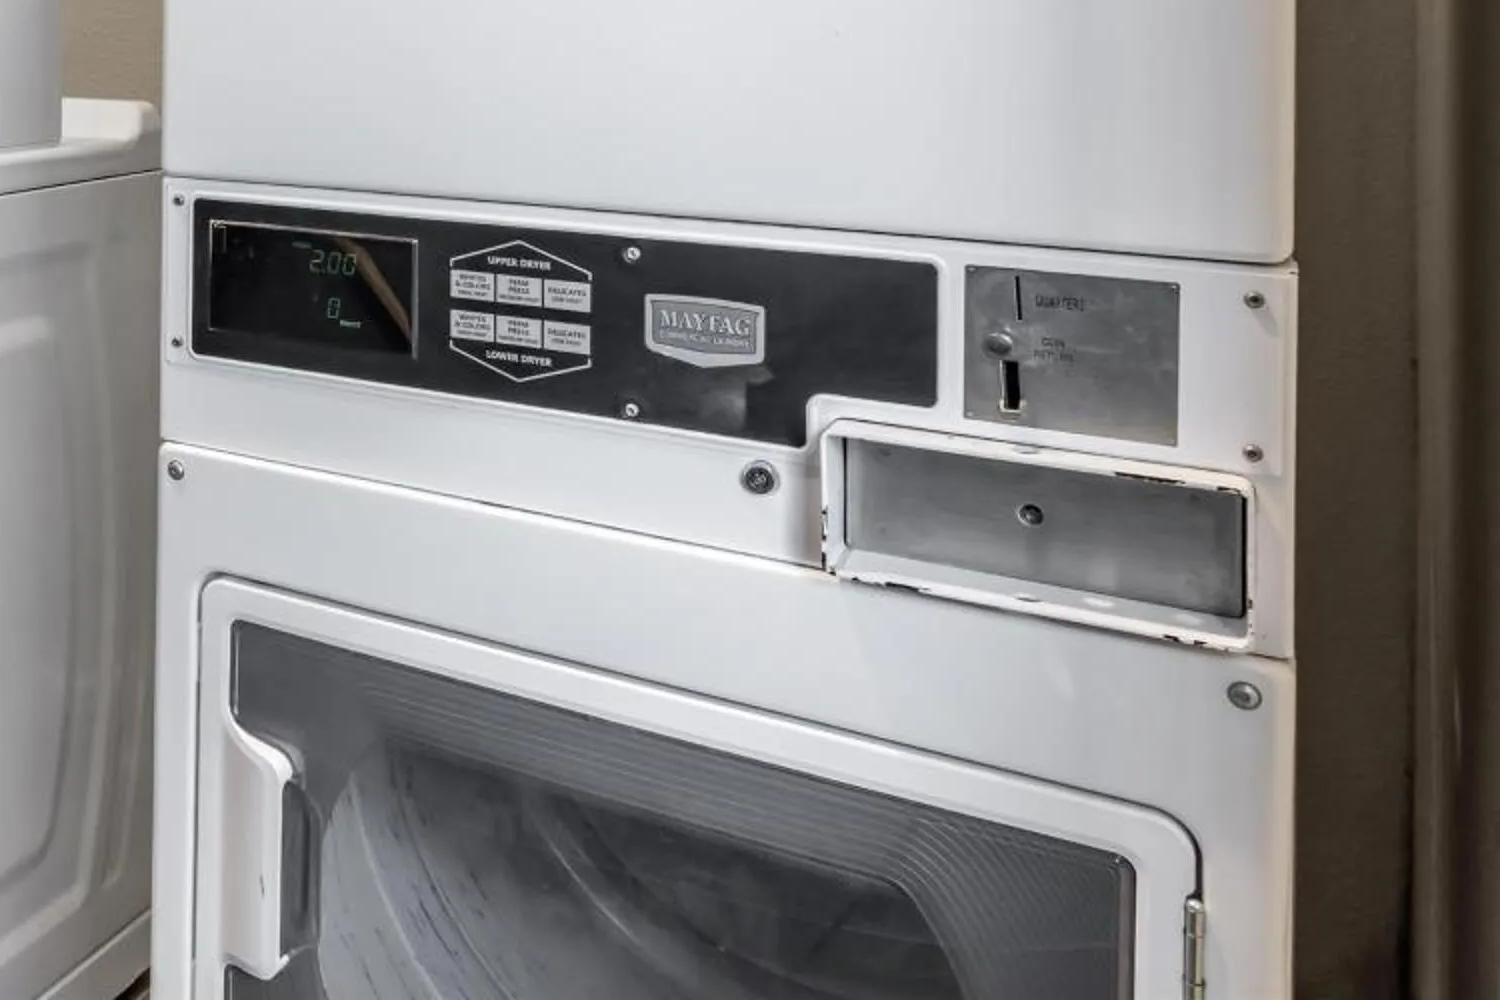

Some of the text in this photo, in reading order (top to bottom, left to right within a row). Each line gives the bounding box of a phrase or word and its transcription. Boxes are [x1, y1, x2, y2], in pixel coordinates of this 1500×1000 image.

[486, 255, 552, 272] UPPER DRYER
[660, 309, 751, 337] MAYTAG
[485, 350, 553, 368] LOWER DRYER
